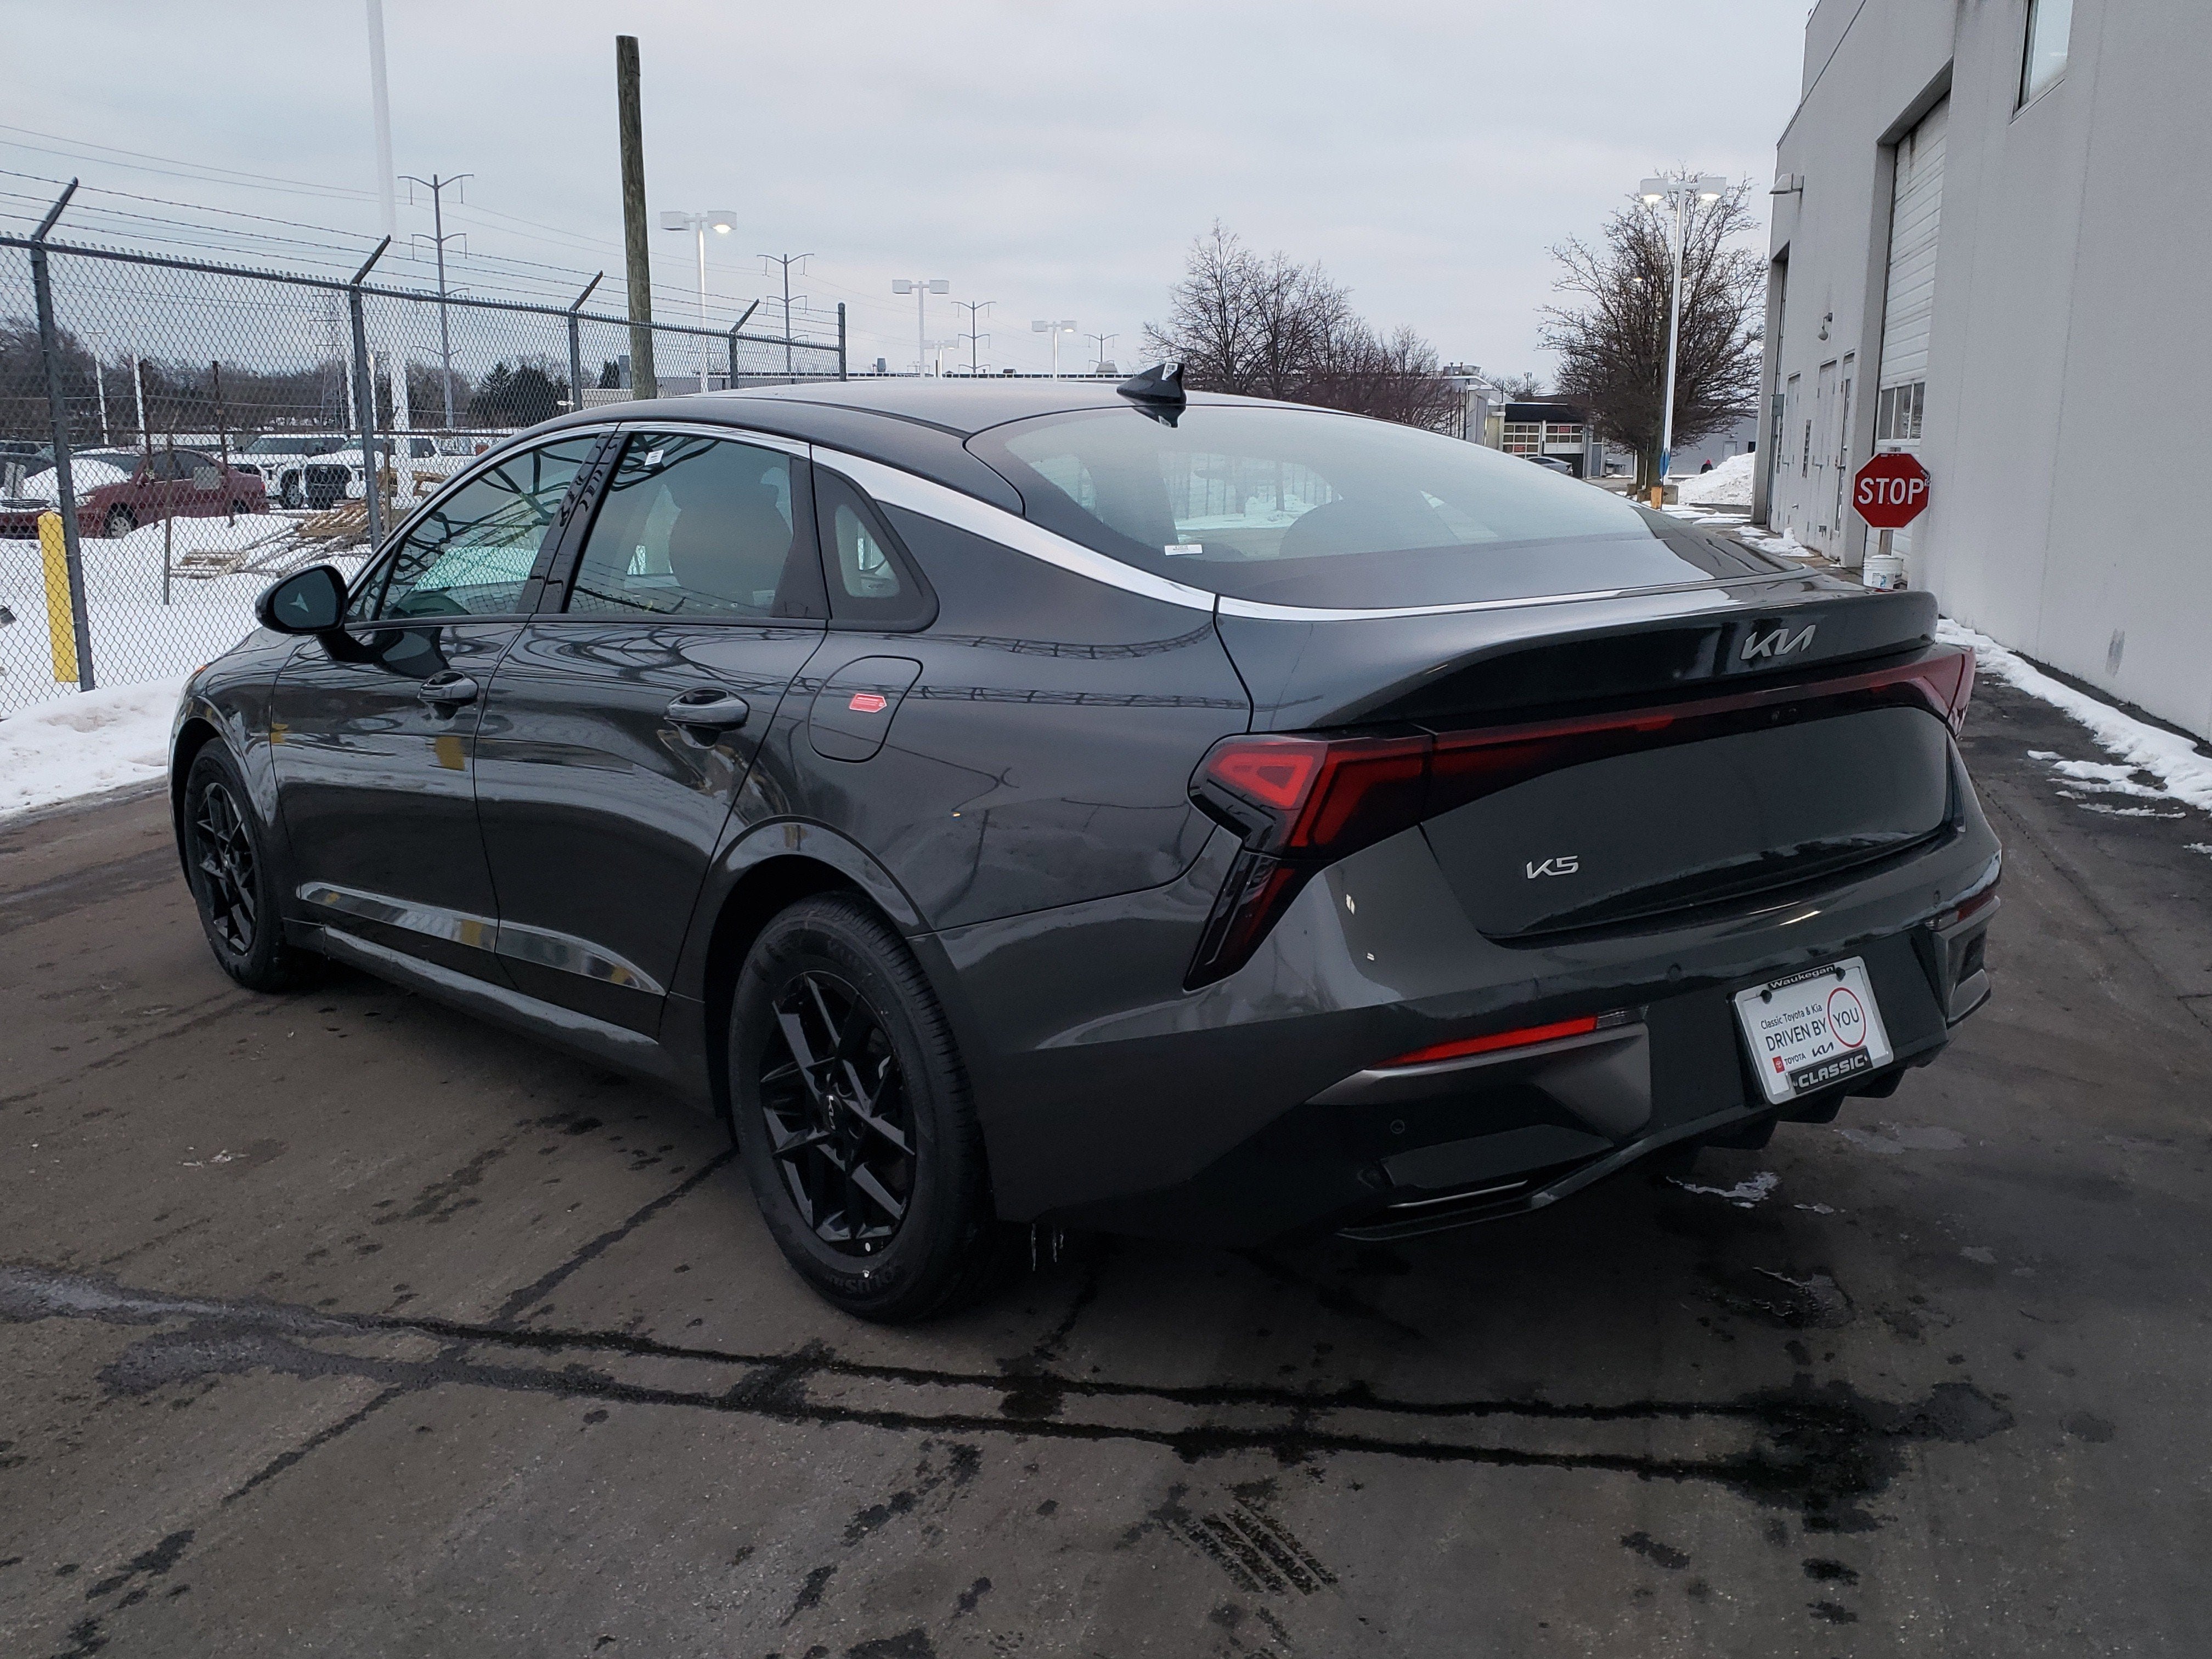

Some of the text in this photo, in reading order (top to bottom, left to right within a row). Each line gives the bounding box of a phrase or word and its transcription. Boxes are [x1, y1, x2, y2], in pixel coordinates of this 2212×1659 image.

[1858, 477, 1924, 505] STOP
[1526, 855, 1579, 879] K5
[1770, 966, 1833, 989] Waukegan
[1760, 1003, 1822, 1030] Classic Toyota & Kia
[1765, 1007, 1860, 1052] DRIVEN BY YOU
[1784, 1052, 1807, 1065] TOYOTA
[1798, 1054, 1865, 1087] CLASSIC
